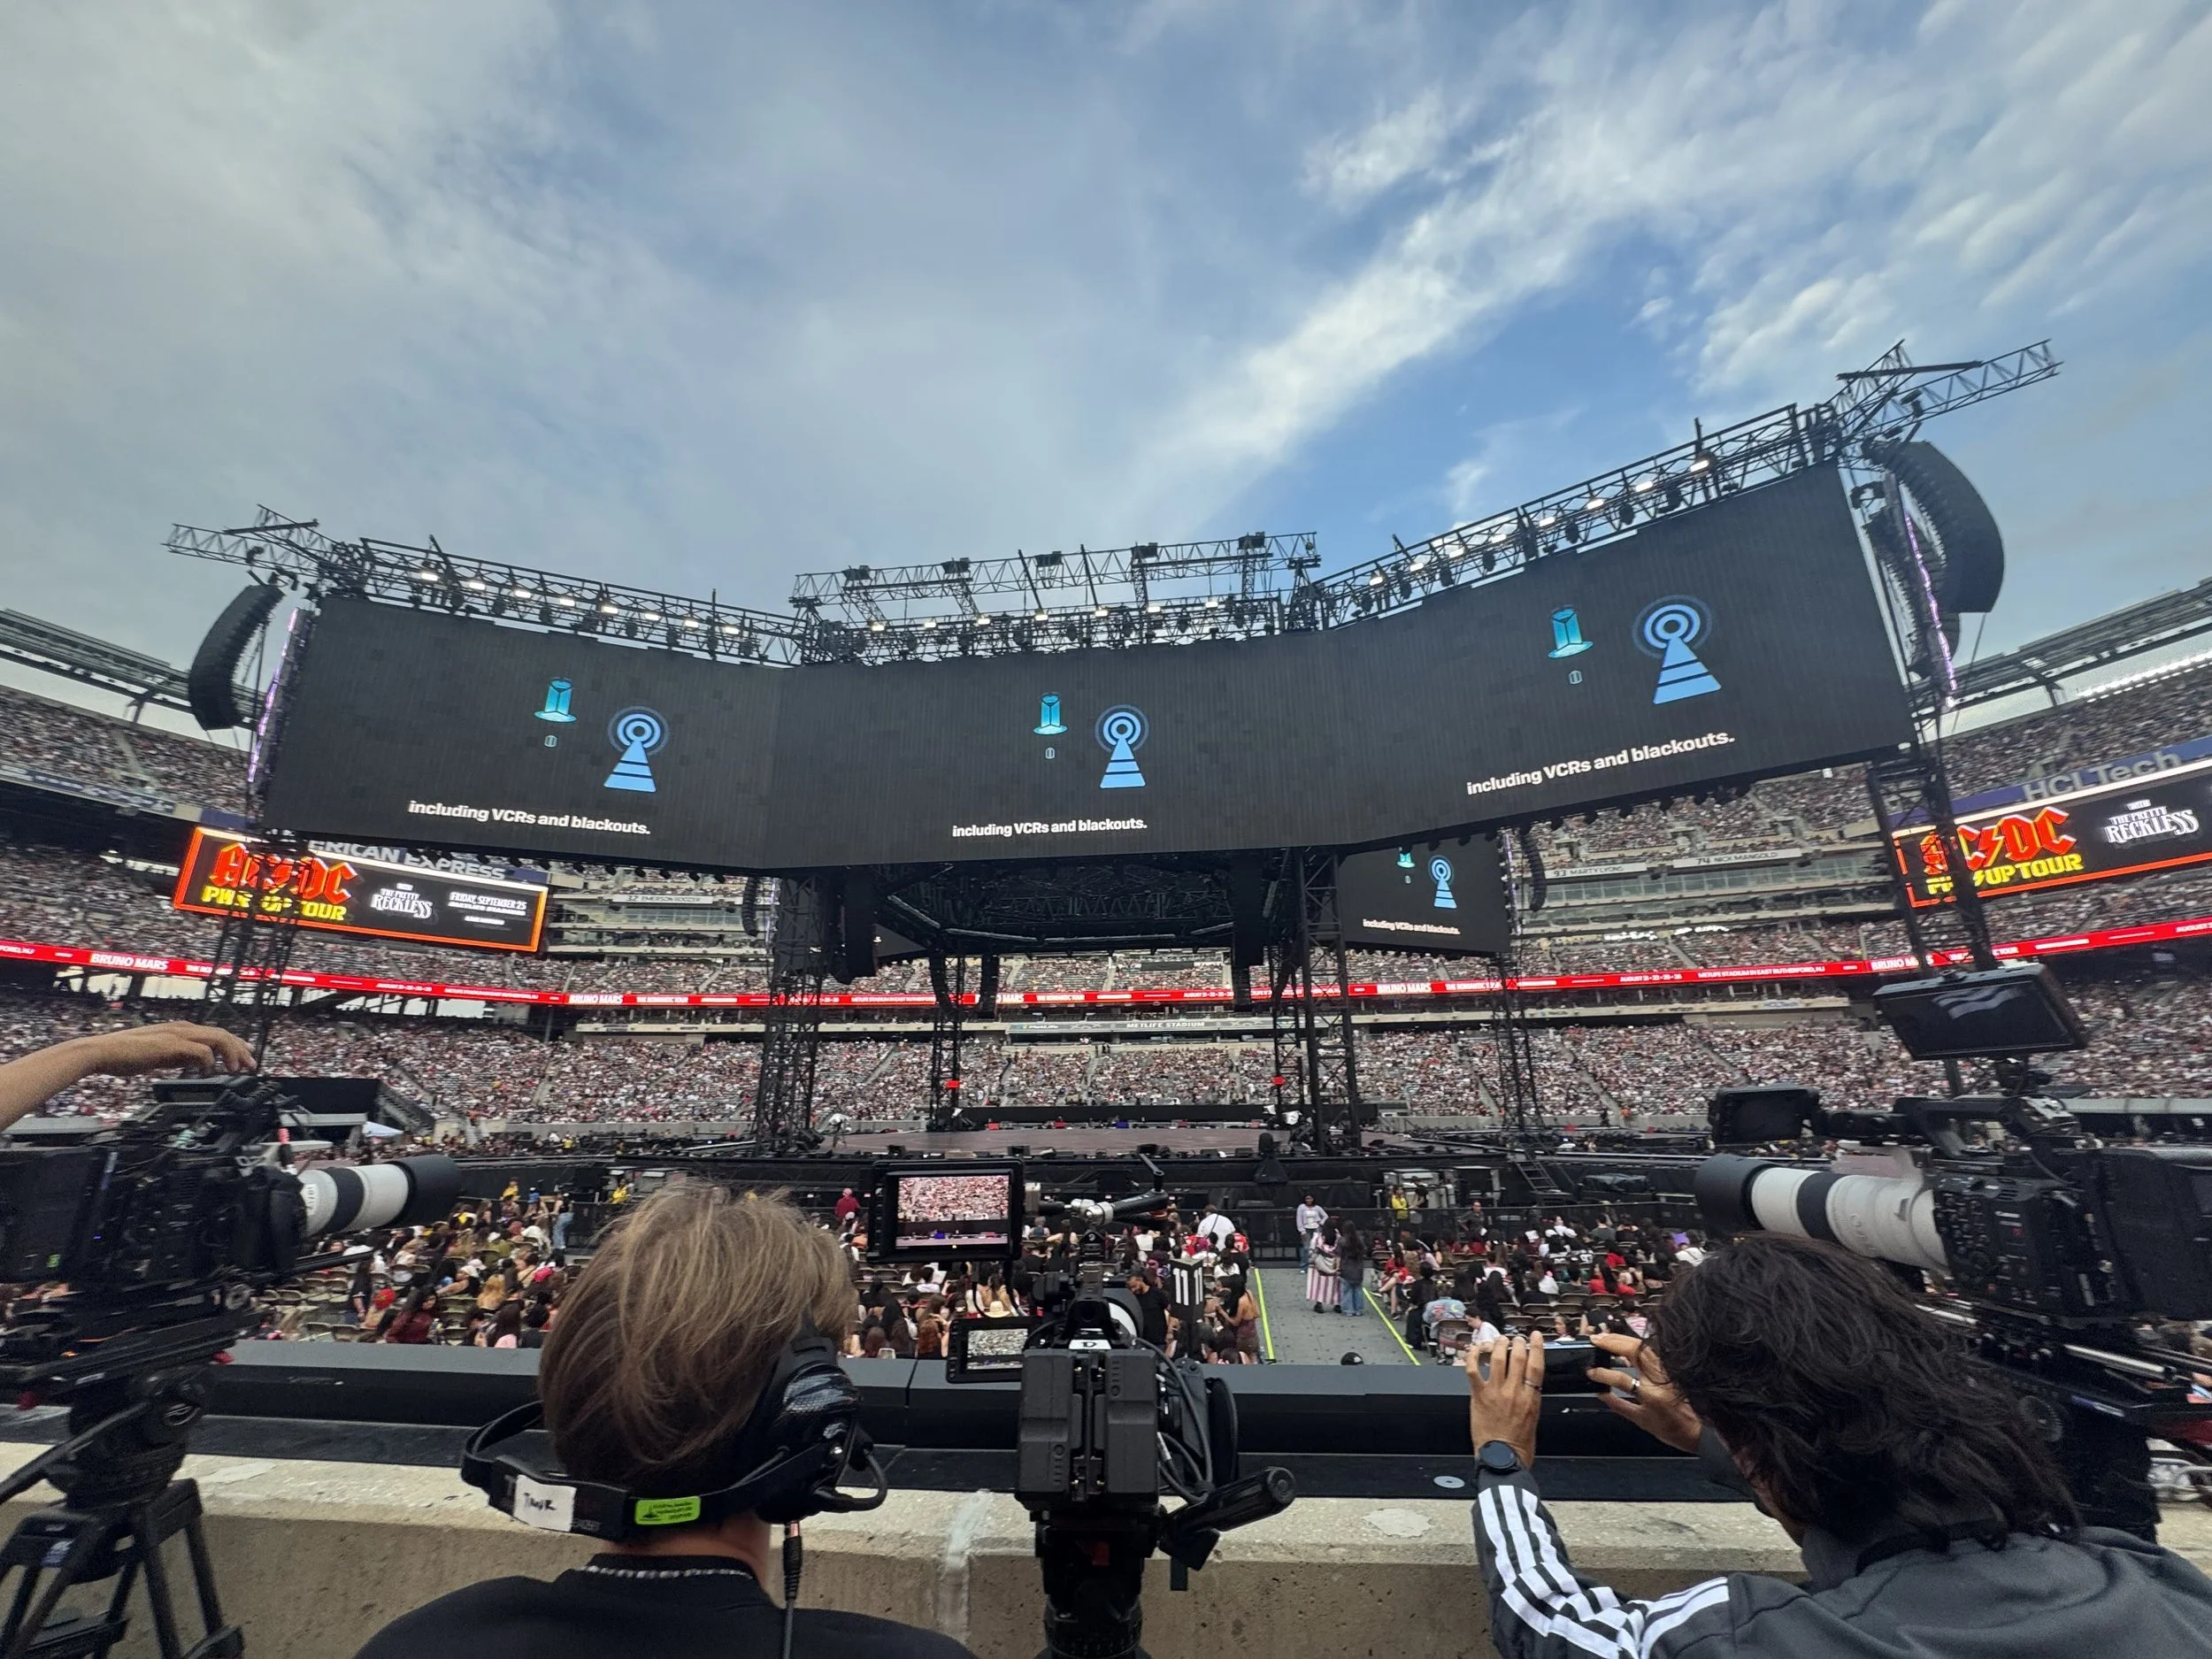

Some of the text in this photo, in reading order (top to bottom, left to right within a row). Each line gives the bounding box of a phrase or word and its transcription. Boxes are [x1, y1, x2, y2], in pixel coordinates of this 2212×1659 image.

[1467, 732, 1736, 795] including VCRs and blackouts.
[409, 800, 651, 834] including VCRs and blackouts.
[2131, 806, 2168, 822] PRETTY
[952, 818, 1148, 838] including VCRs and blackouts.
[2103, 810, 2200, 843] RECKLESS
[308, 839, 401, 864] ERICAN
[1697, 856, 1710, 865] 74
[2016, 853, 2085, 879] TOUR
[370, 893, 434, 919] RECKLESS
[449, 891, 477, 905] FRIDAY,
[478, 895, 516, 910] SEPTEMBER
[516, 900, 528, 910] 25
[1363, 918, 1395, 932] including
[1394, 921, 1414, 931] VCRs
[89, 953, 170, 971] BRUNO MARS
[1870, 960, 1903, 971] BRUNO
[1376, 982, 1432, 994] BRUNO MARS
[569, 995, 624, 1004] BRUNO MARS
[1002, 994, 1025, 1004] MARS
[1172, 1267, 1190, 1306] 11
[1194, 1266, 1203, 1305] 11
